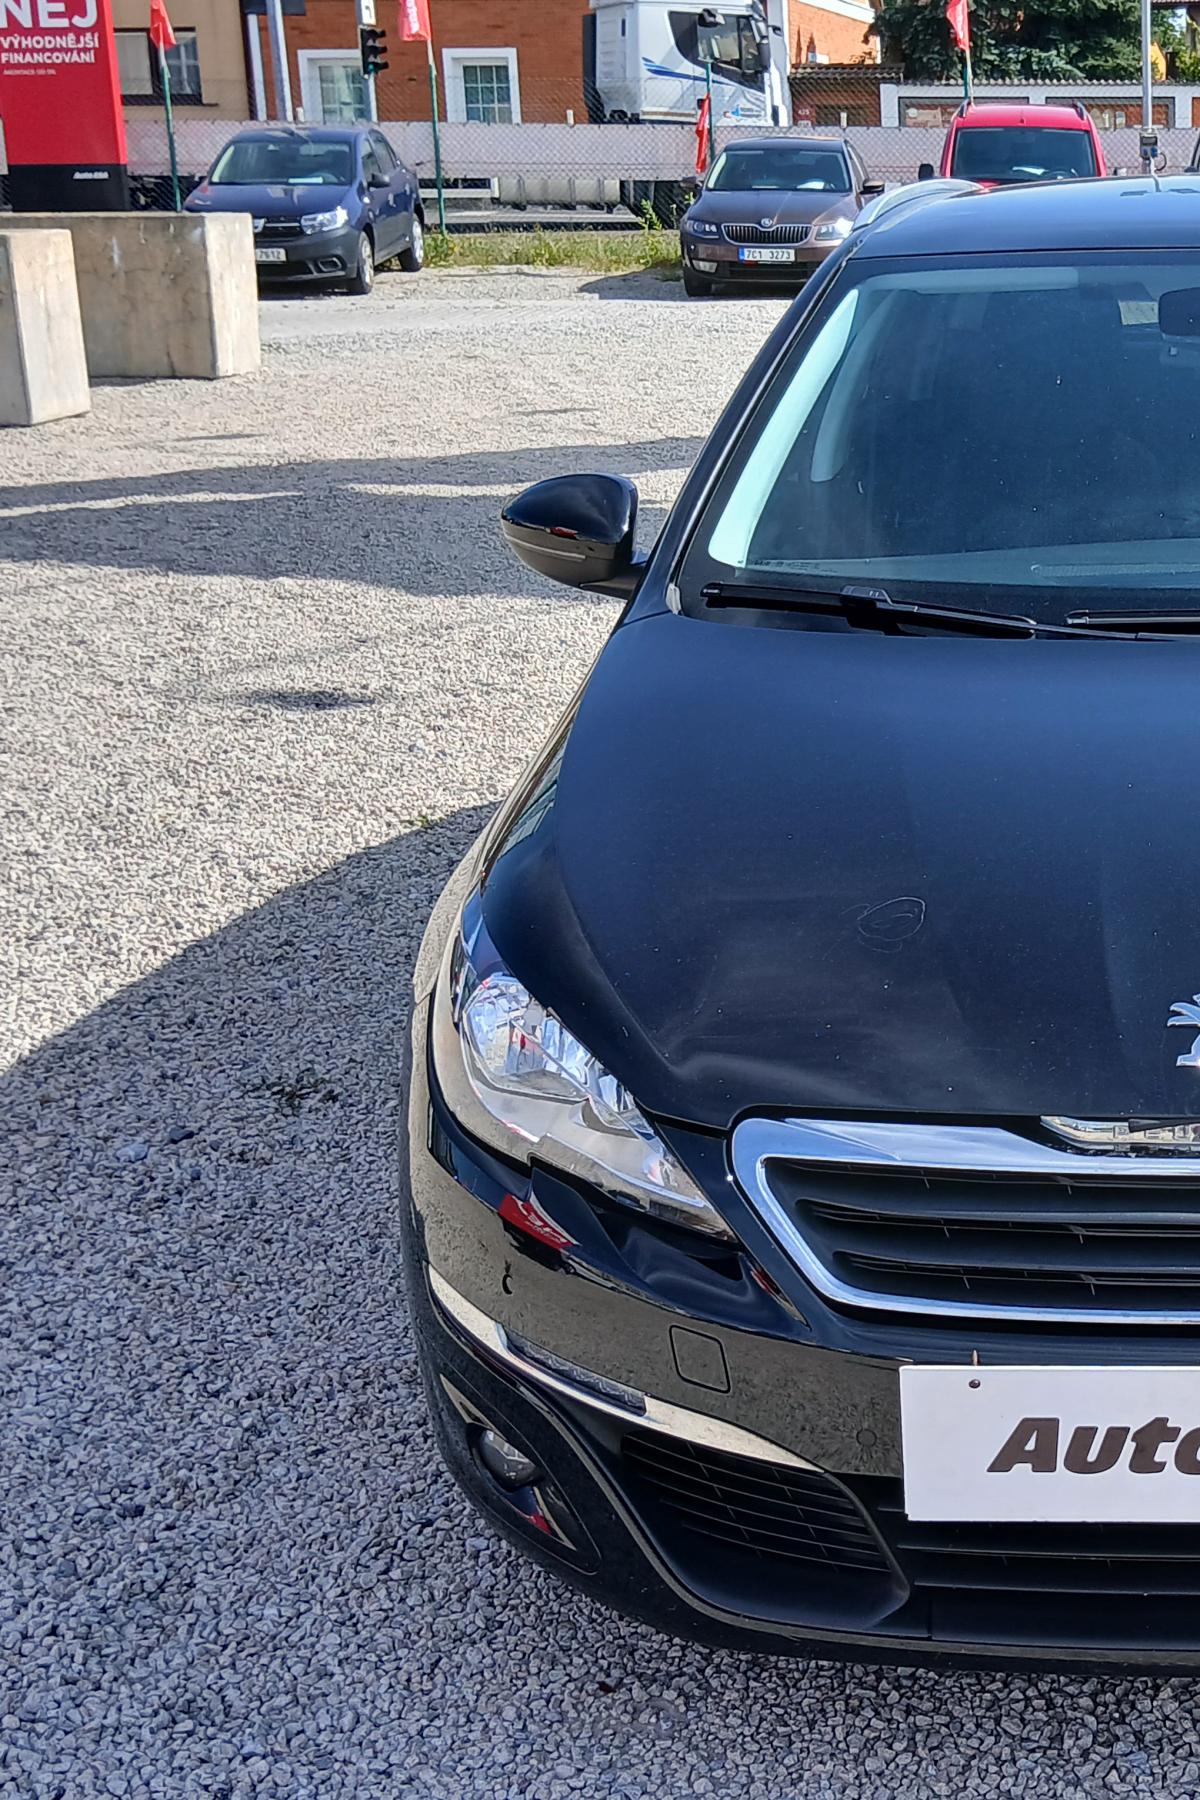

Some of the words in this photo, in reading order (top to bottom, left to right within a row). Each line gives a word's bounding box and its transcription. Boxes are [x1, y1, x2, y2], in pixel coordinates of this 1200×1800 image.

[0, 0, 98, 28] NEJ
[0, 32, 99, 49] VÝHODNĚJŠÍ
[1, 49, 95, 64] FINANCOVÁNÍ
[746, 250, 763, 260] 7C1
[769, 250, 791, 260] 3273
